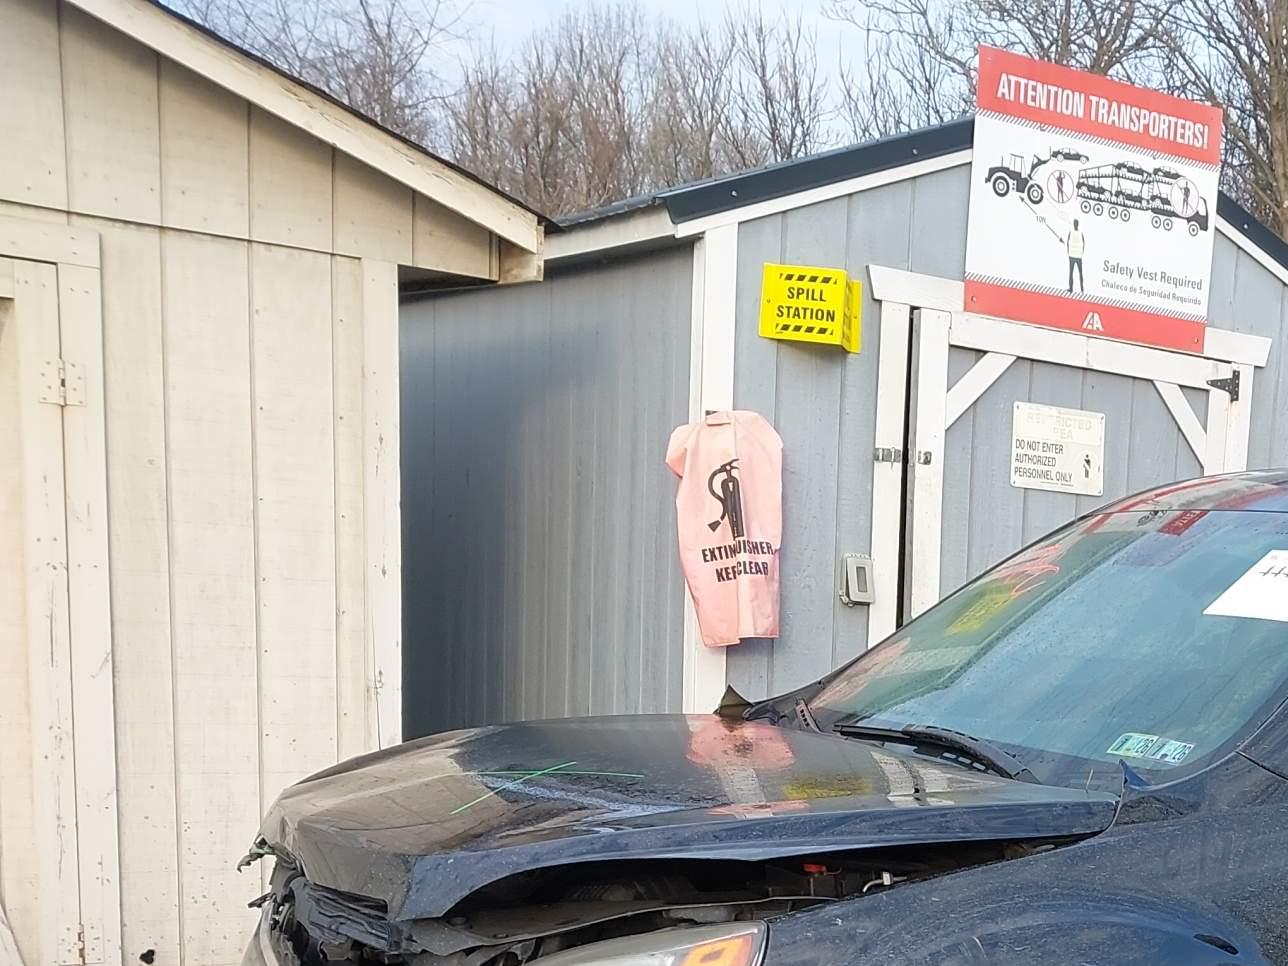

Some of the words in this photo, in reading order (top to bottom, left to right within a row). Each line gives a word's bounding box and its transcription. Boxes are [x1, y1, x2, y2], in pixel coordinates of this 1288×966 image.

[997, 73, 1085, 118] ATTENTION
[1089, 95, 1209, 149] TRANSPORTERS!
[1103, 260, 1134, 279] Safety
[1137, 266, 1158, 282] Vest
[1160, 271, 1203, 290] Required
[787, 286, 826, 302] SPILL
[1101, 279, 1128, 292] Chaleco
[1129, 284, 1138, 294] de
[1139, 286, 1171, 300] Seguridad
[776, 305, 835, 322] STATION
[1015, 439, 1026, 450] DO
[1027, 440, 1040, 452] NOT
[1042, 442, 1064, 455] ENTER
[1015, 453, 1057, 467] AUTHORIZED
[1014, 466, 1054, 481] PERSONNEL
[1056, 471, 1073, 483] ONLY
